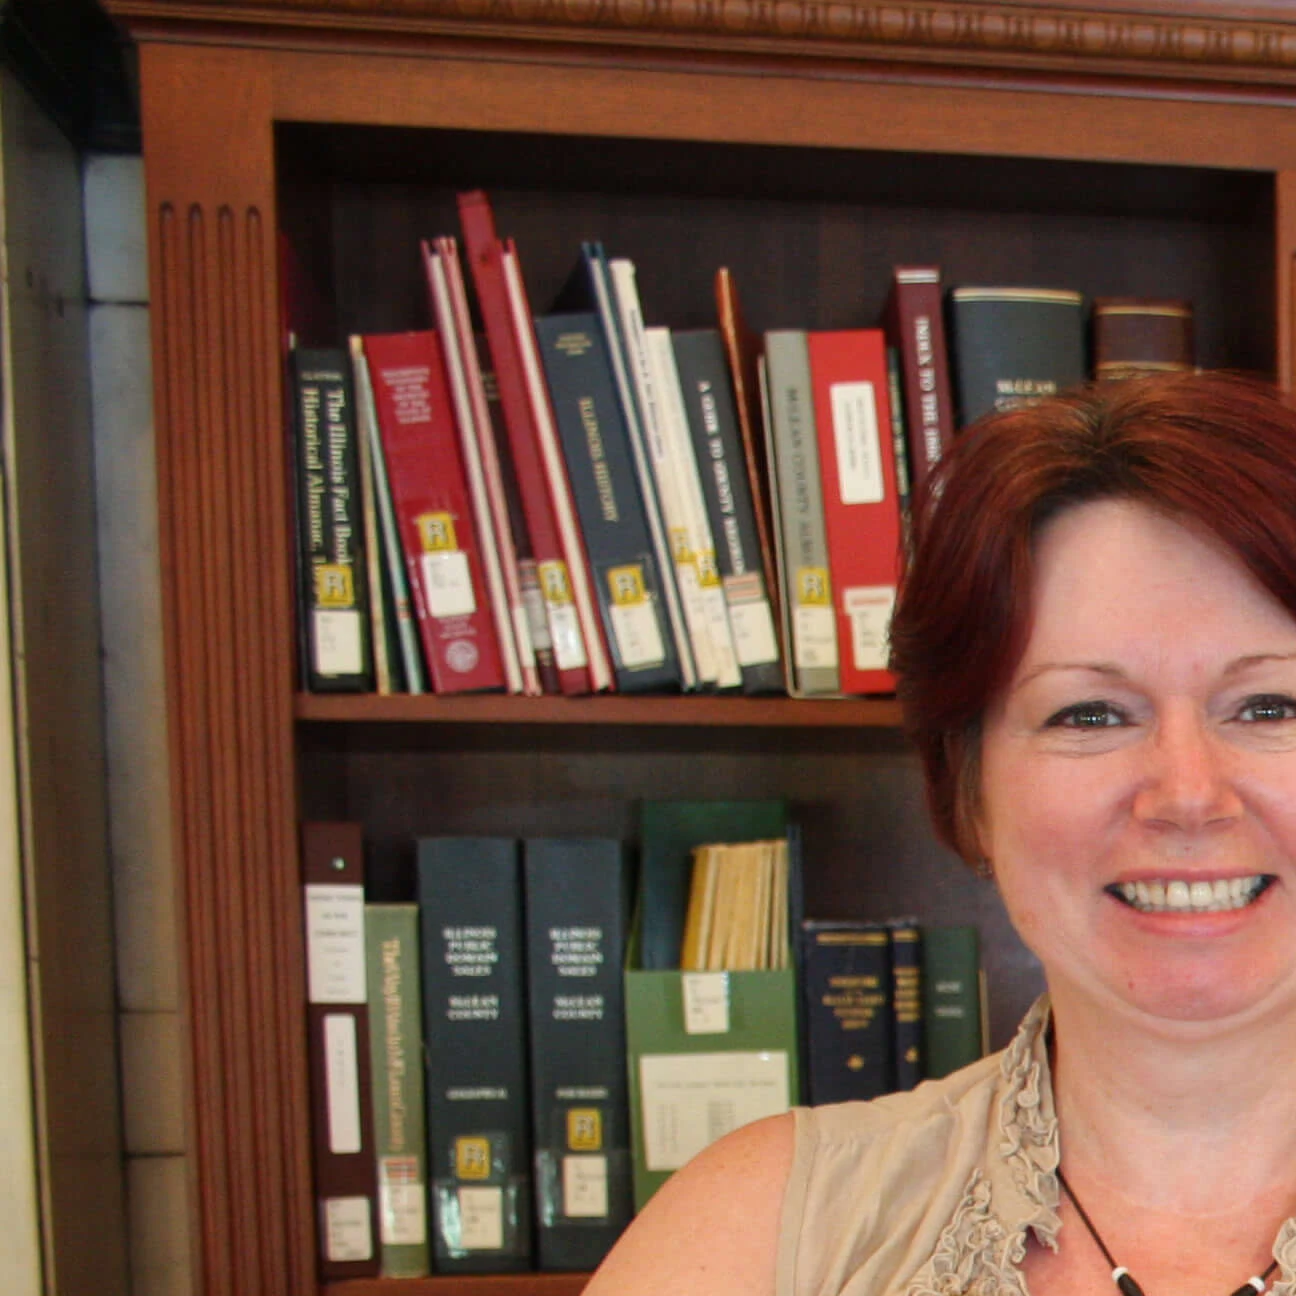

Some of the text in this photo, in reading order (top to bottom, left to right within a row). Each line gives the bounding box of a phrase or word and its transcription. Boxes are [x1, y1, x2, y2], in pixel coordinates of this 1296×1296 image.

[326, 389, 345, 422] The
[302, 388, 324, 470] Historical
[328, 423, 348, 484] Illinois
[332, 486, 349, 522] Fact
[323, 570, 346, 597] R
